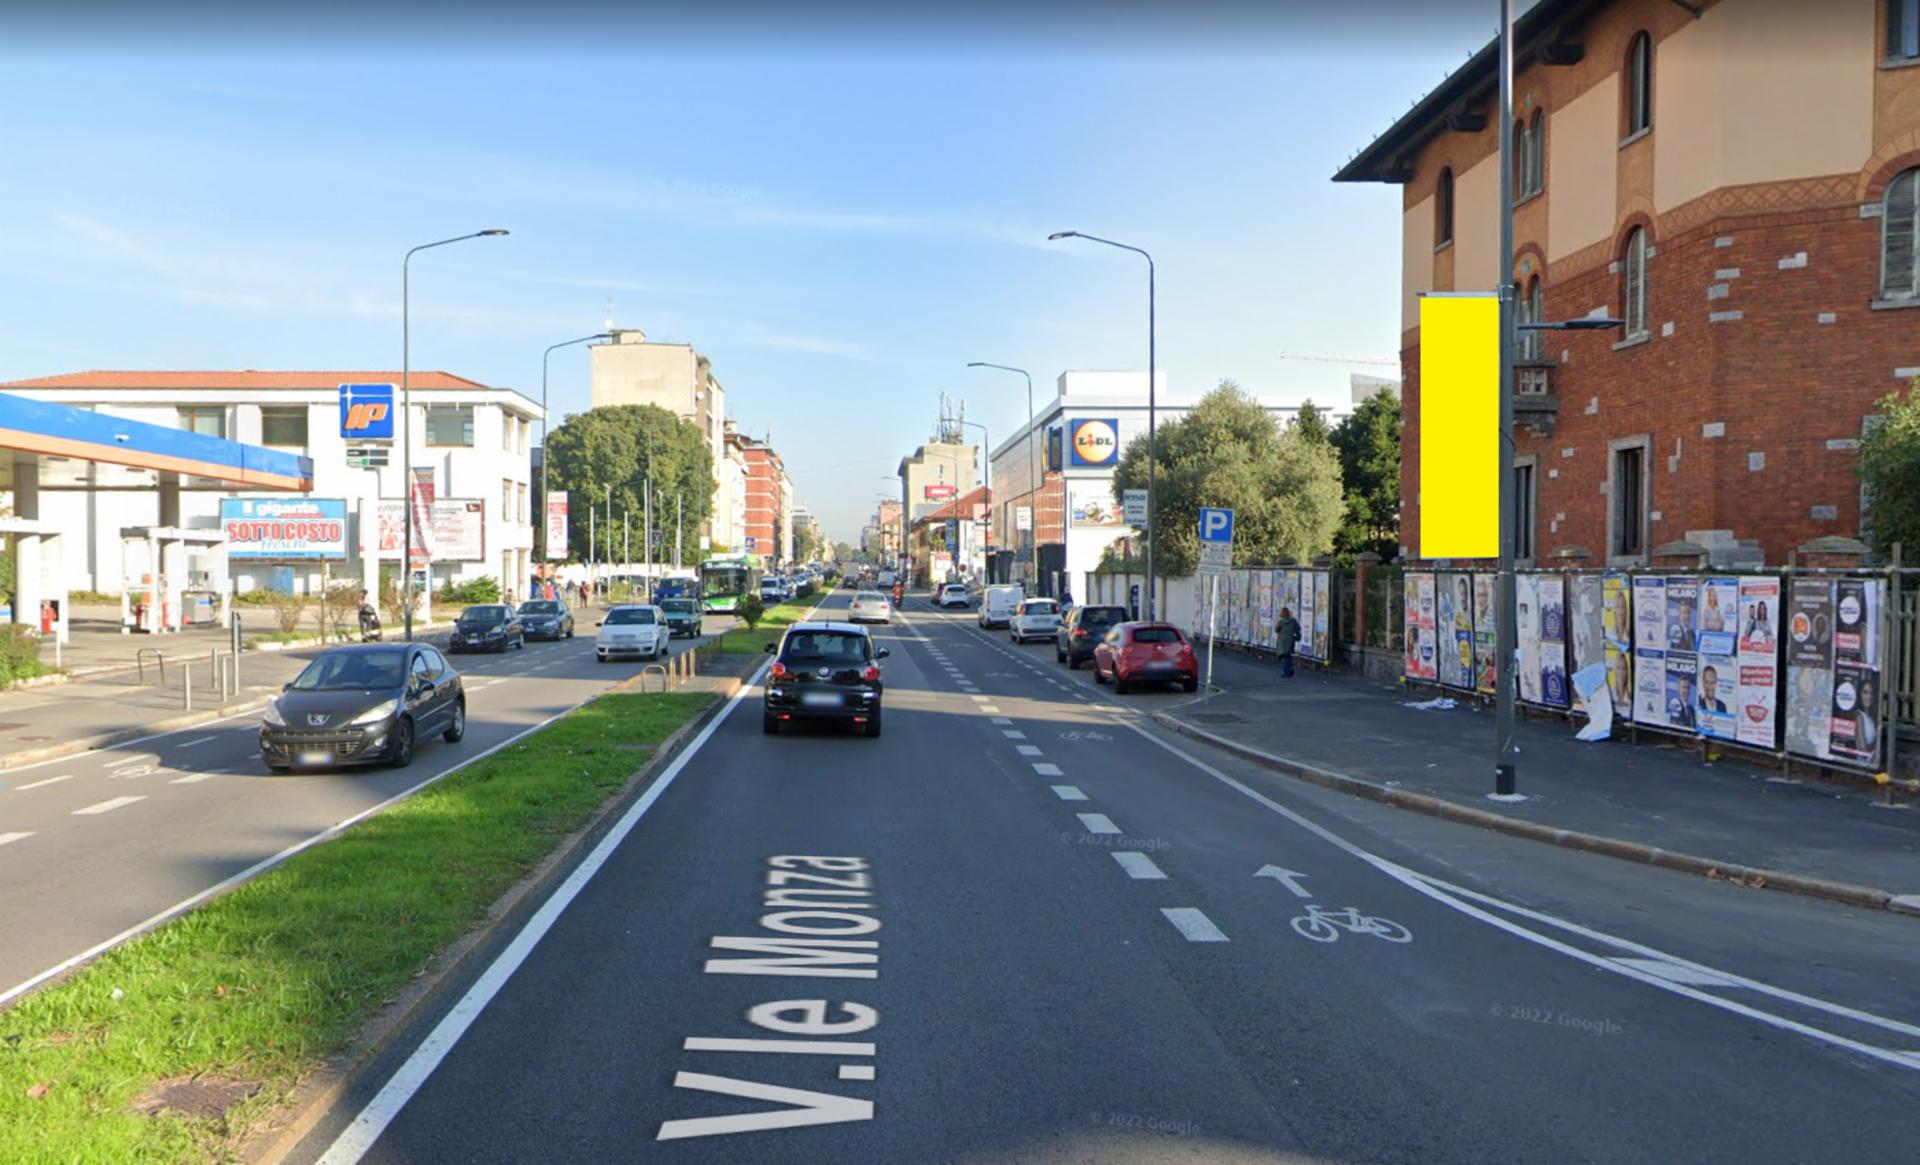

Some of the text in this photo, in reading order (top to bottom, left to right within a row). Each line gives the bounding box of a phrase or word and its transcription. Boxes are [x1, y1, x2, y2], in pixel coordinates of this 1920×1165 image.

[1205, 511, 1227, 538] P
[1667, 587, 1697, 599] MILANO
[1667, 662, 1697, 674] MILANO
[656, 855, 882, 1141] V.le Monza
